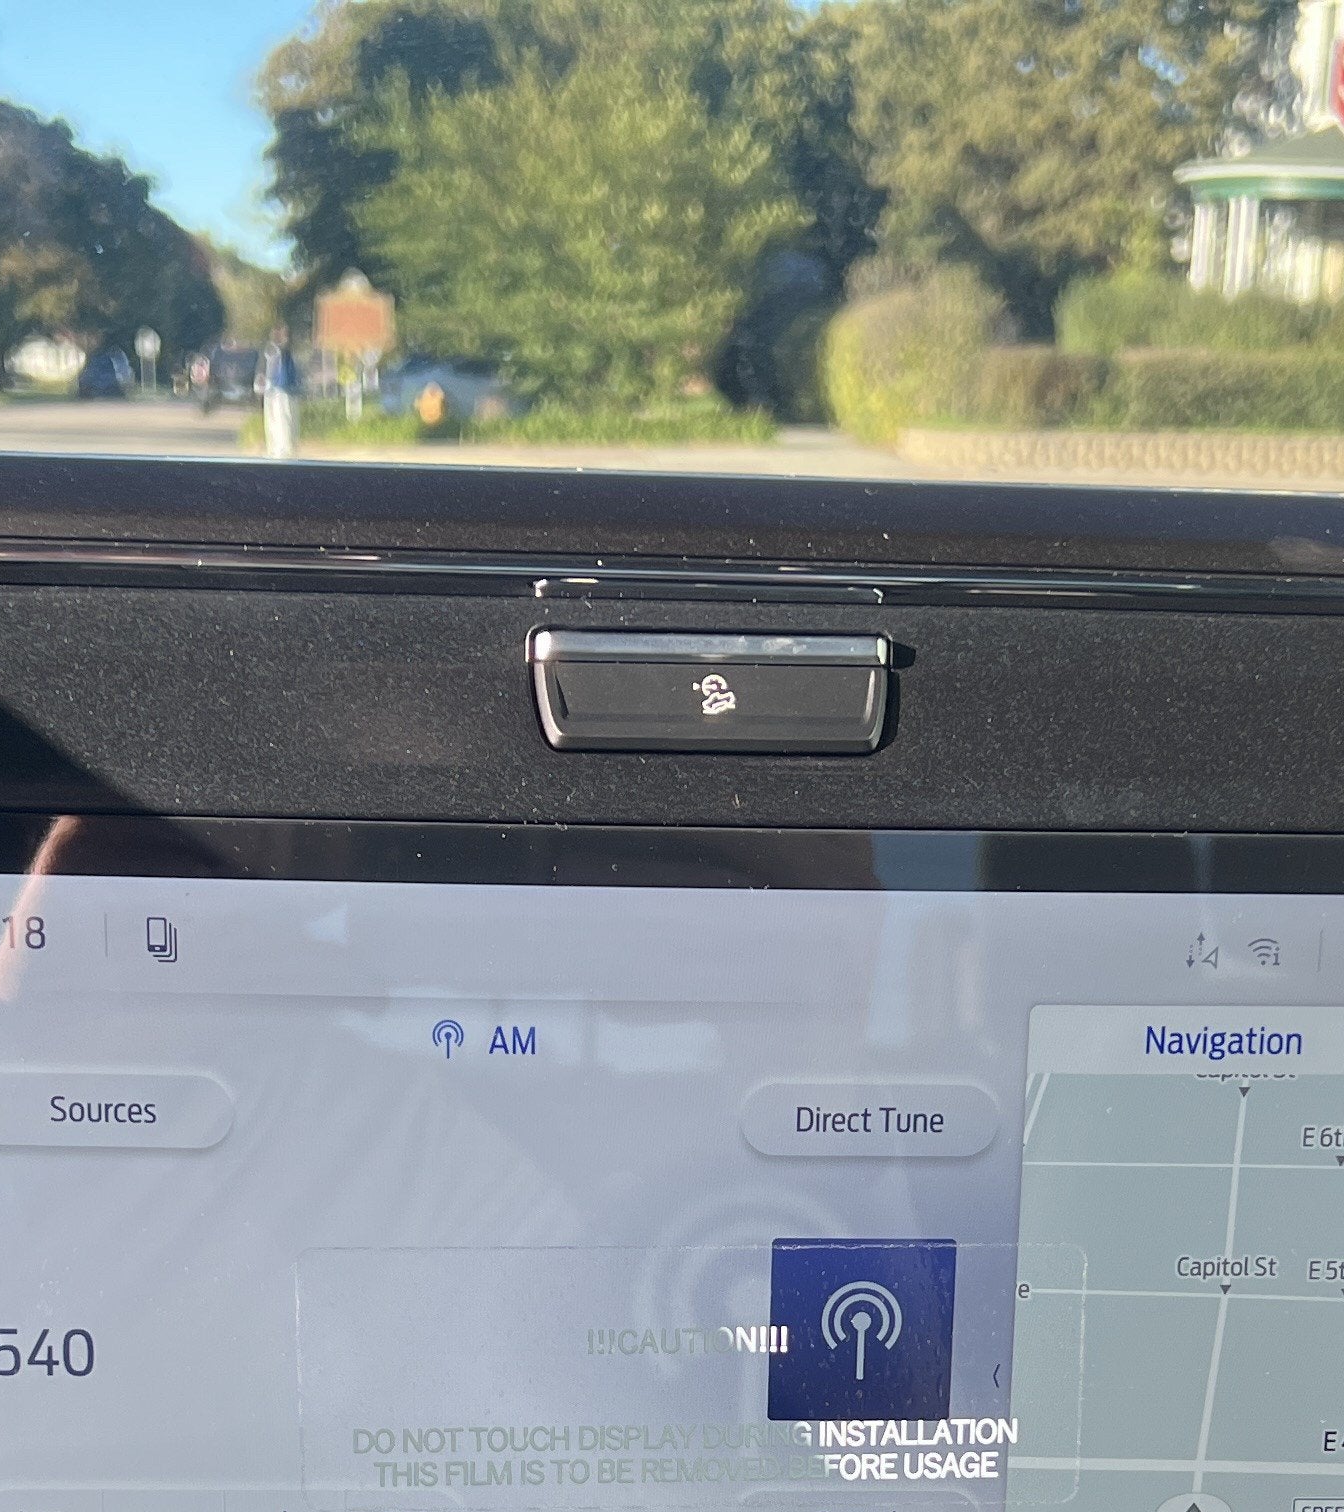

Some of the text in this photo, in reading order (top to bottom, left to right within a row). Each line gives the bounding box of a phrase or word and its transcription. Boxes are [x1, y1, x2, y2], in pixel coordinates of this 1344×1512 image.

[488, 1026, 537, 1055] AM
[1145, 1026, 1303, 1060] Navigation
[50, 1096, 157, 1125] Sources
[796, 1107, 944, 1133] Direct Tune
[1302, 1128, 1314, 1148] E
[1176, 1257, 1277, 1279] Capitol St
[1308, 1261, 1320, 1280] E
[352, 1418, 1018, 1454] DO NOT TOUCH DISPLAY DURING INSTALLATION
[1324, 1431, 1337, 1451] E
[374, 1451, 999, 1487] THIS FILM IS TO BE REMOVED BEFORE USAGE
